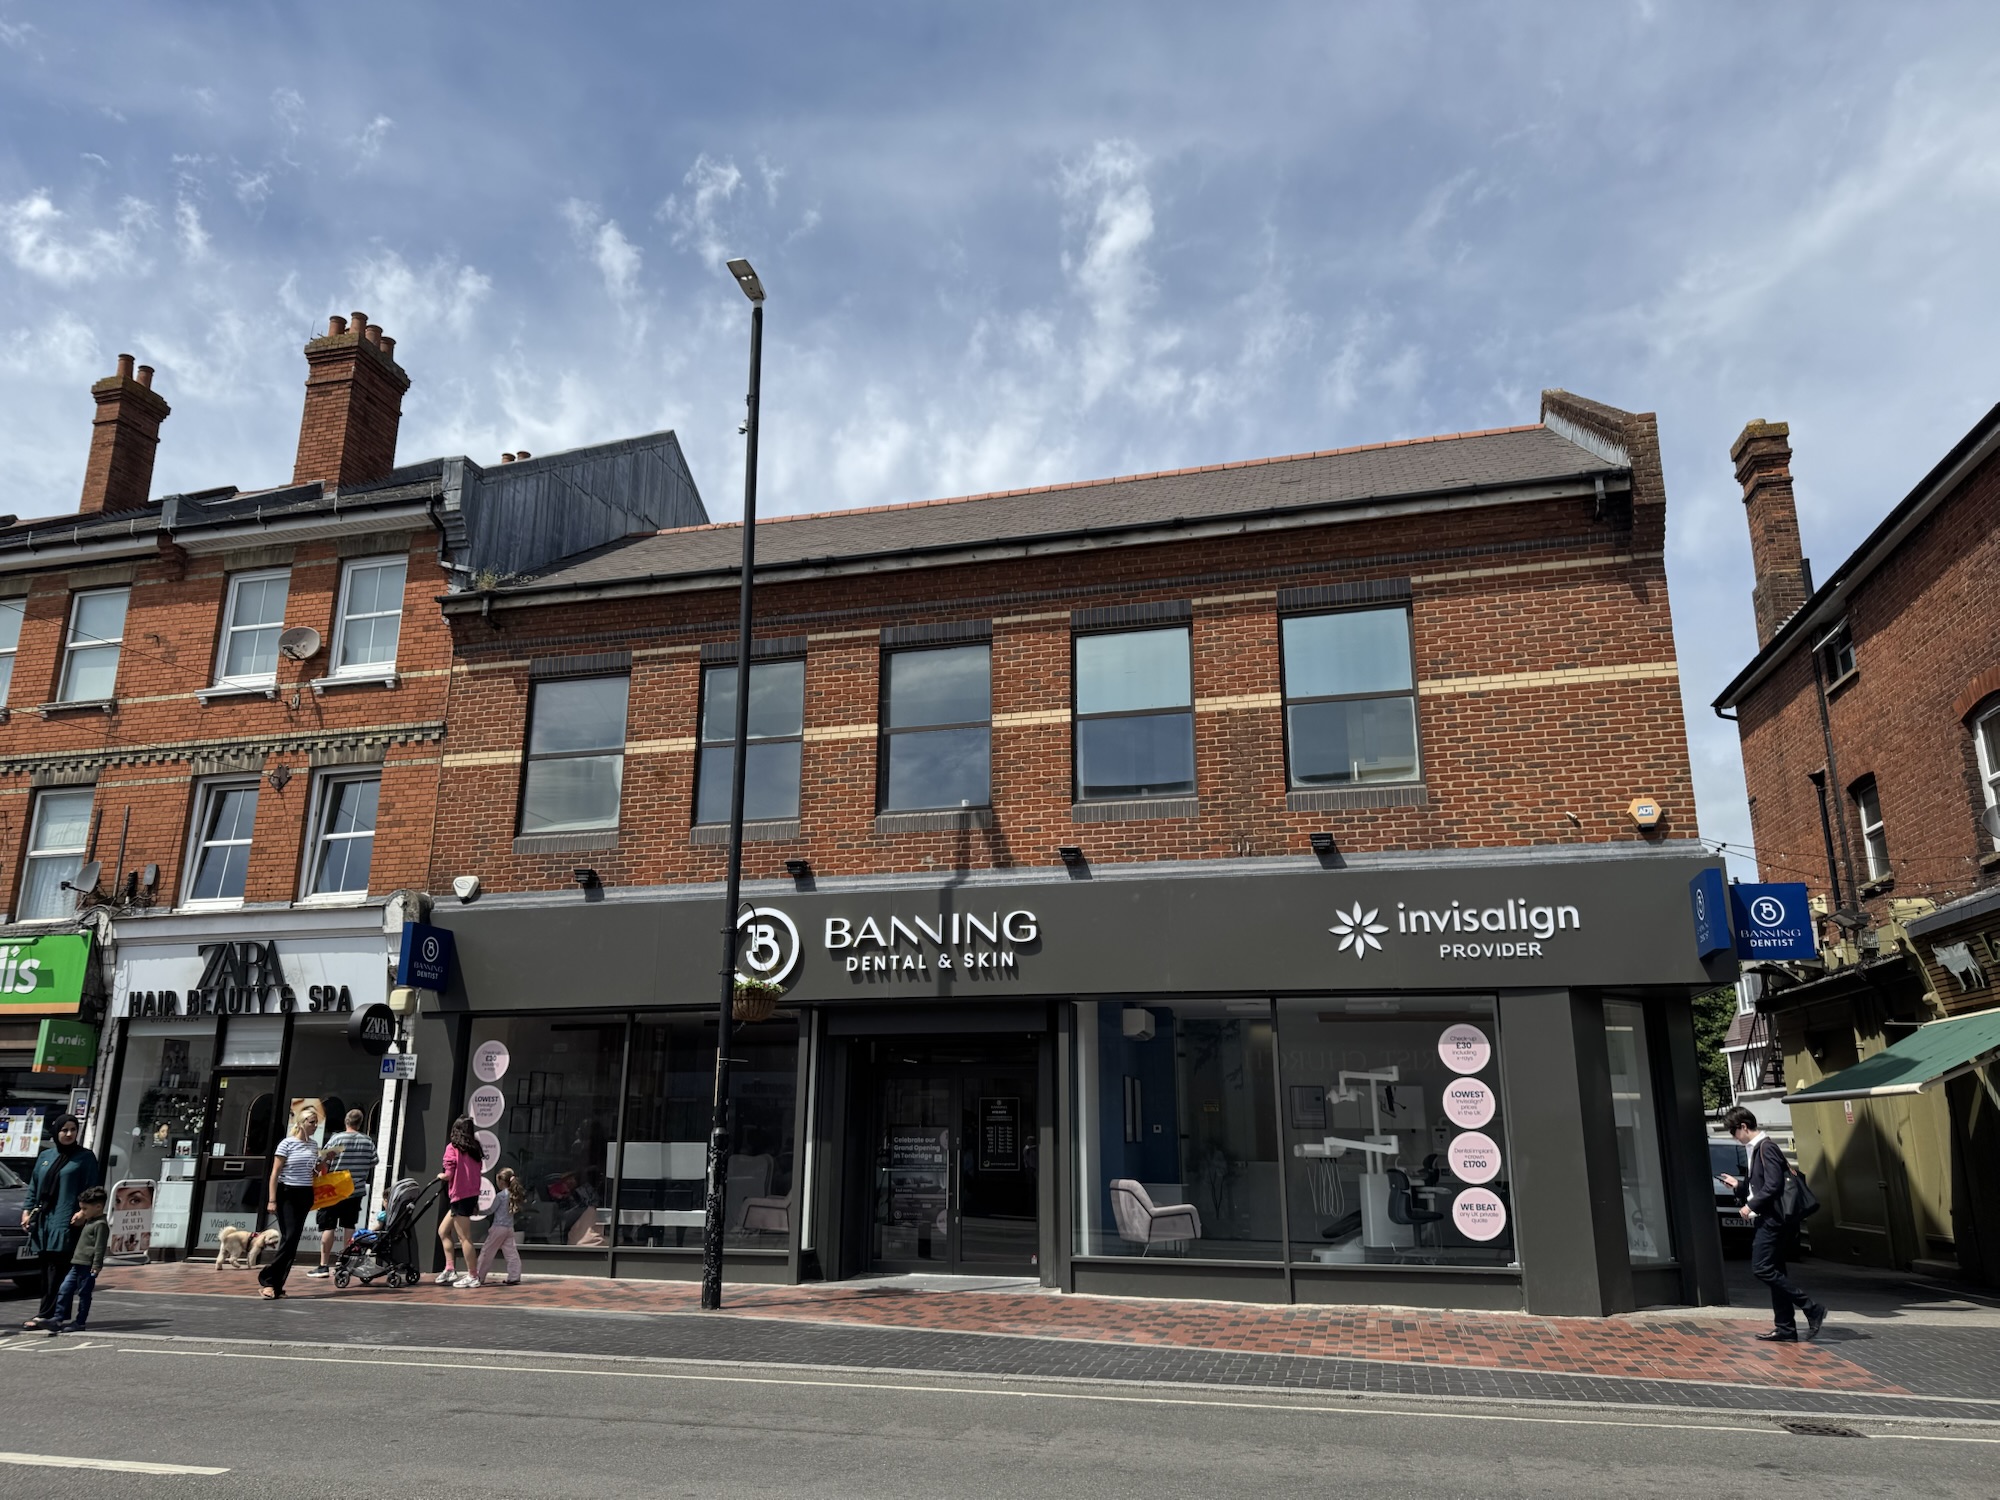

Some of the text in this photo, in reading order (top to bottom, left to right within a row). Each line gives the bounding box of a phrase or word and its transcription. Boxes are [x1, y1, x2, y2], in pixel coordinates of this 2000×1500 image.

[1638, 806, 1654, 815] ADT
[1397, 898, 1581, 939] invisalign
[824, 910, 1038, 949] BANNING
[1740, 928, 1801, 938] BANNING
[1750, 938, 1794, 948] DENTIST
[1439, 942, 1543, 959] PROVIDER
[196, 940, 290, 990] ZARA
[846, 952, 1014, 972] DENTAL & SKIN
[416, 970, 438, 980] DENTIST
[128, 985, 352, 1017] HAIR BEAUTY & SPA
[365, 1017, 389, 1034] ZARA
[51, 1033, 87, 1046] Londis
[914, 1144, 940, 1152] Opening
[901, 1152, 932, 1160] Tonbridge
[1463, 1160, 1487, 1168] £1700
[1460, 1203, 1497, 1211] WE BEAT
